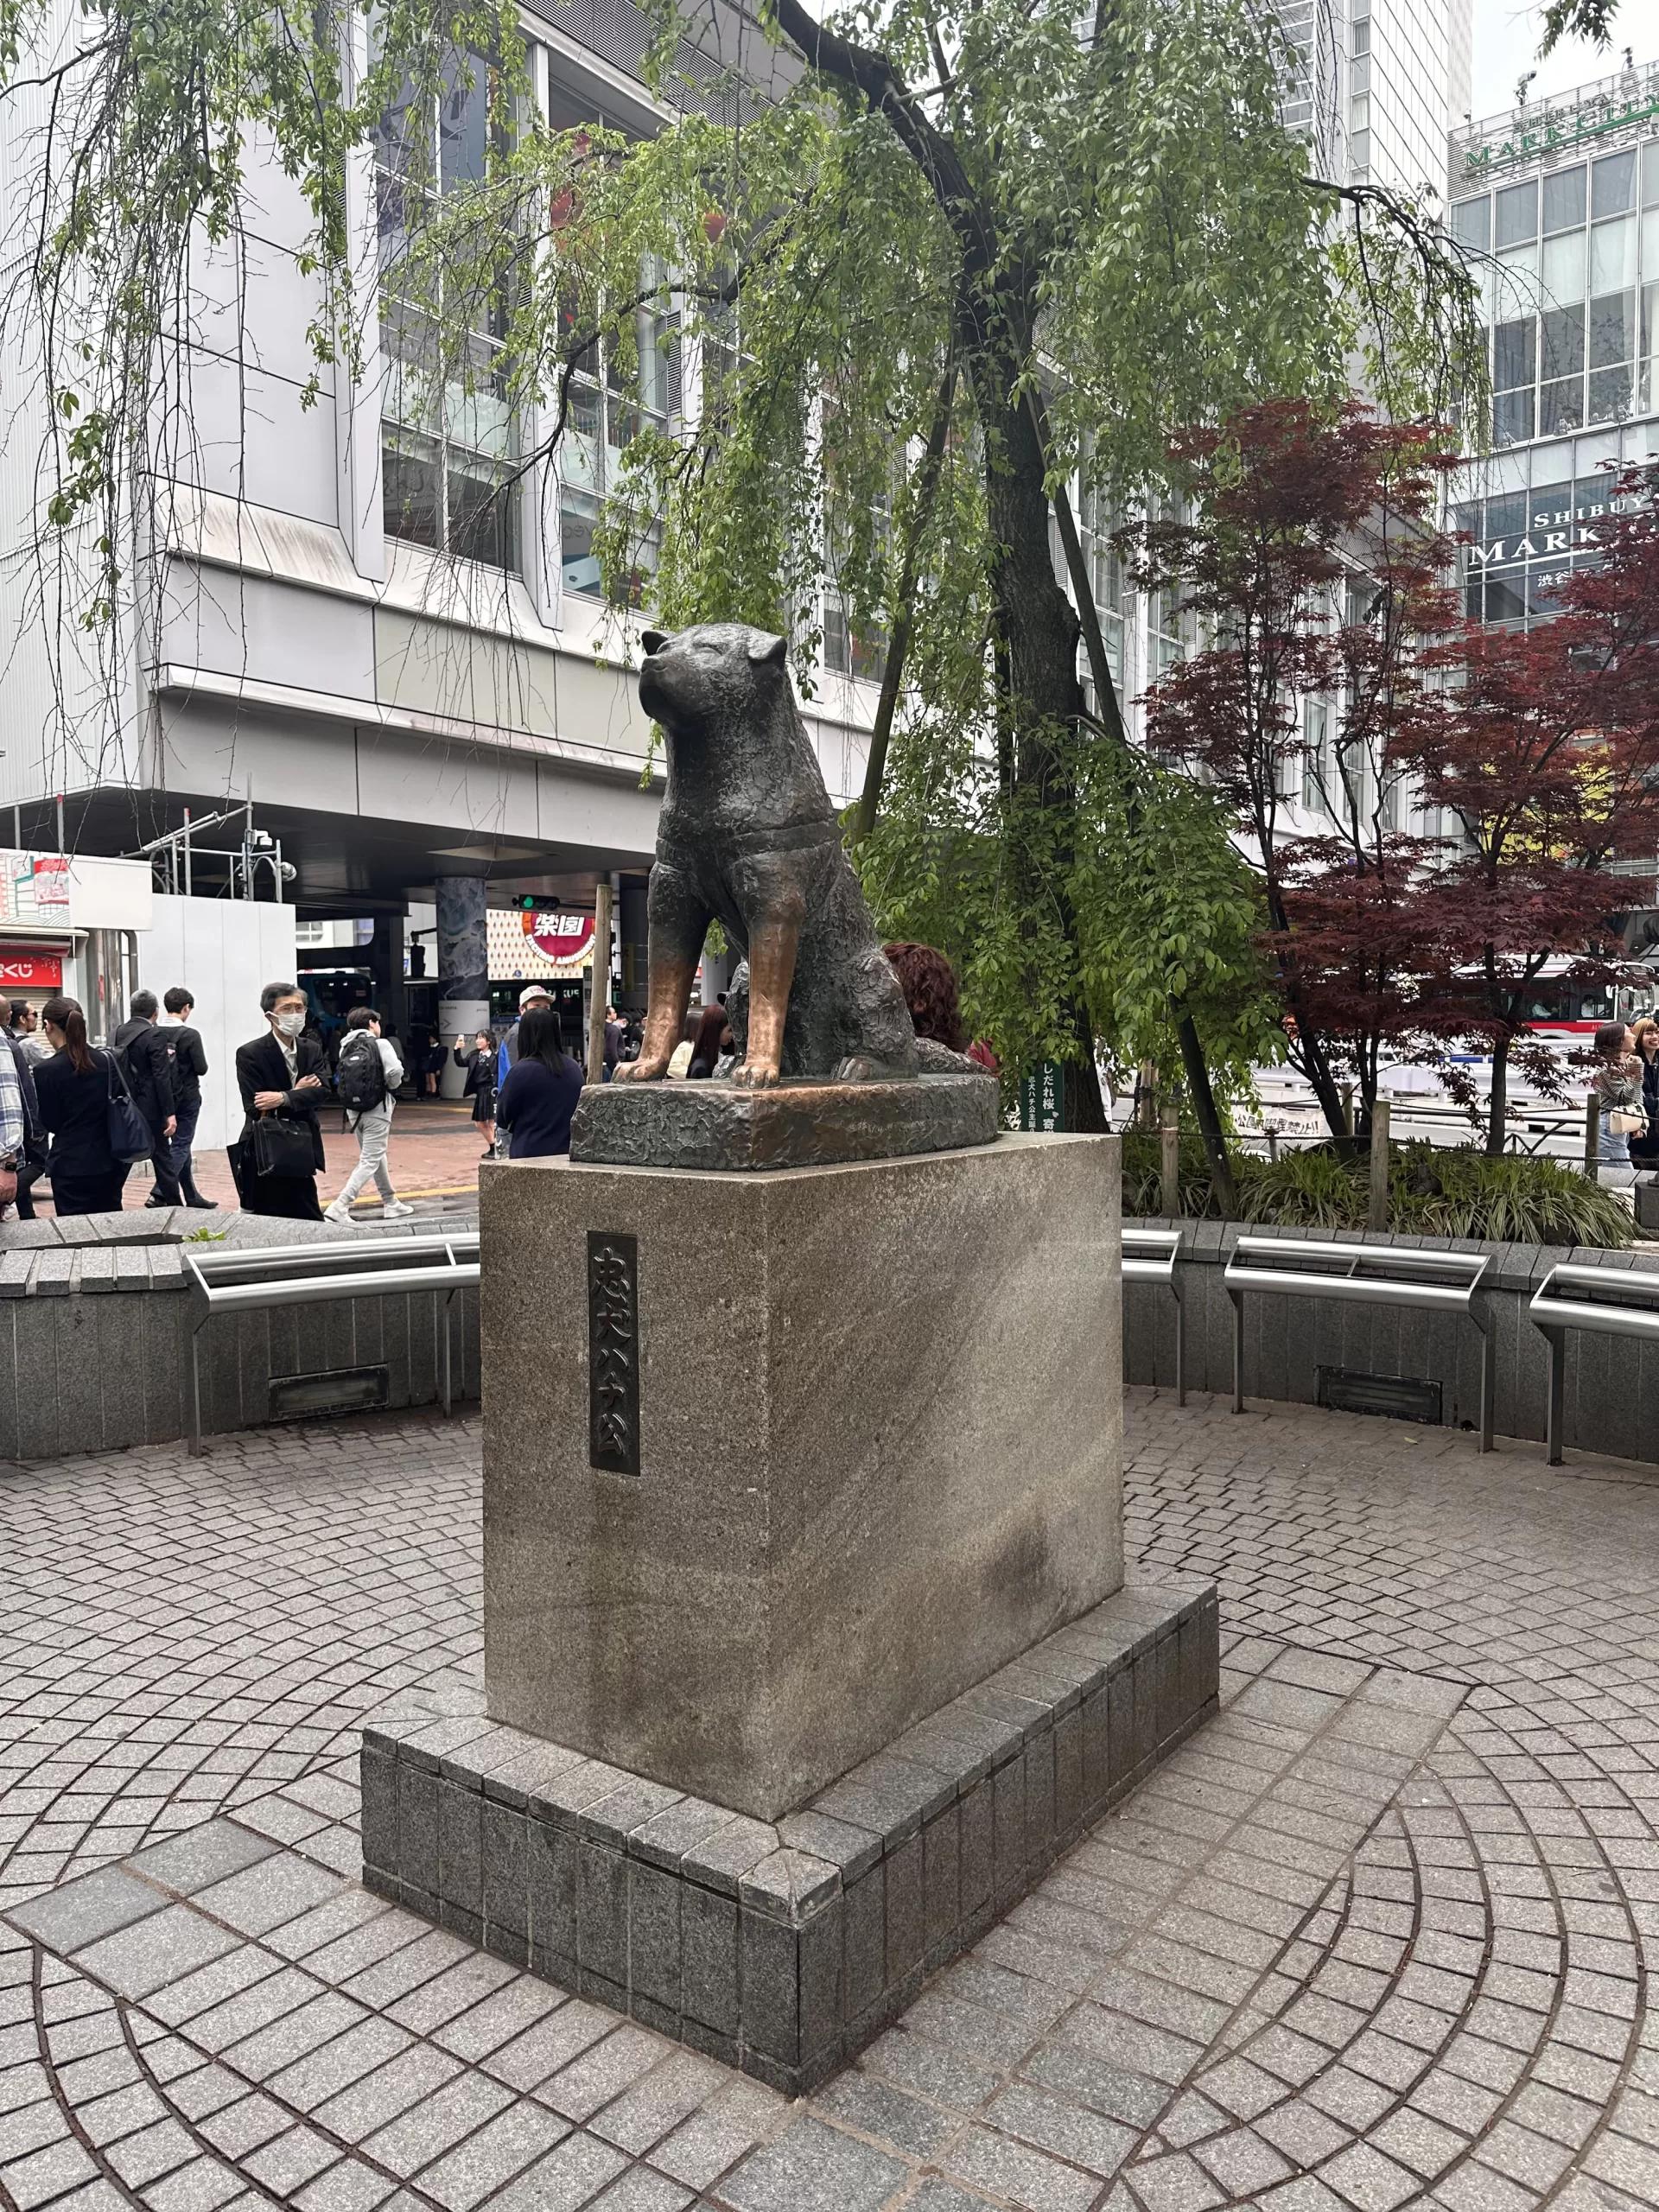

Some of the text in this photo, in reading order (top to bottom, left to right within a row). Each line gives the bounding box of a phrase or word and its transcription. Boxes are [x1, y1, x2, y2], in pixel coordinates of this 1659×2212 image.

[1513, 93, 1611, 133] SHIBUYA
[1465, 127, 1563, 170] MARK
[1534, 495, 1654, 528] SHIBUY
[1469, 527, 1601, 566] MARK
[534, 913, 584, 937] 楽園
[1042, 1063, 1055, 1110] しだれ桜
[590, 1246, 632, 1457] 忠犬ハチ公
